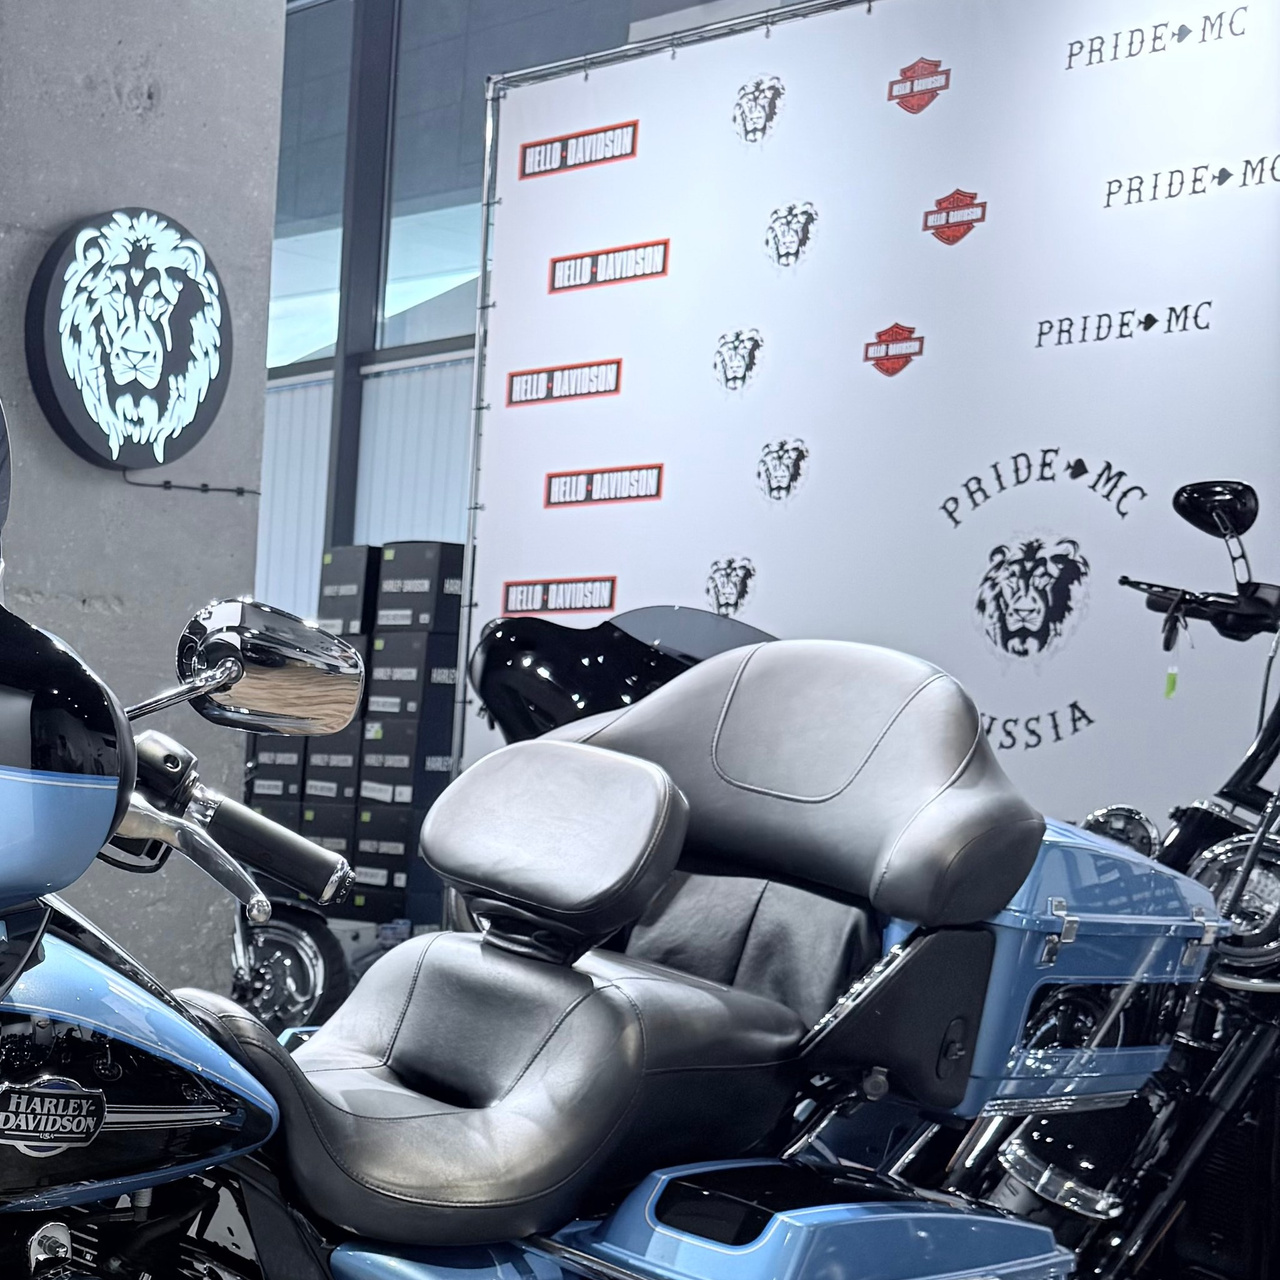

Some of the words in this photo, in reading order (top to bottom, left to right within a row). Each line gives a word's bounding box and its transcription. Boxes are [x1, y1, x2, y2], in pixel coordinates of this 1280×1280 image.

[1065, 21, 1169, 70] PRIDE
[1198, 6, 1248, 43] MC
[524, 142, 562, 175] HELLO
[567, 126, 635, 166] DAVIDSON
[1103, 164, 1210, 208] PRIDE
[554, 257, 592, 289] HELLO
[596, 244, 665, 282] DAVIDSON
[1035, 309, 1137, 348] PRIDE
[1163, 300, 1213, 334] MC
[512, 372, 548, 402] HELLO
[552, 363, 618, 397] DAVIDSON
[550, 474, 587, 503] HELLO
[591, 468, 660, 500] DAVIDSON
[938, 447, 1060, 529] PRIDE
[1088, 460, 1148, 519] MC
[507, 584, 543, 611] HELLO
[547, 580, 613, 610] DAVIDSON
[980, 700, 1095, 751] SSIA
[8, 1094, 96, 1115] HARLEY-
[40, 1132, 55, 1140] USA
